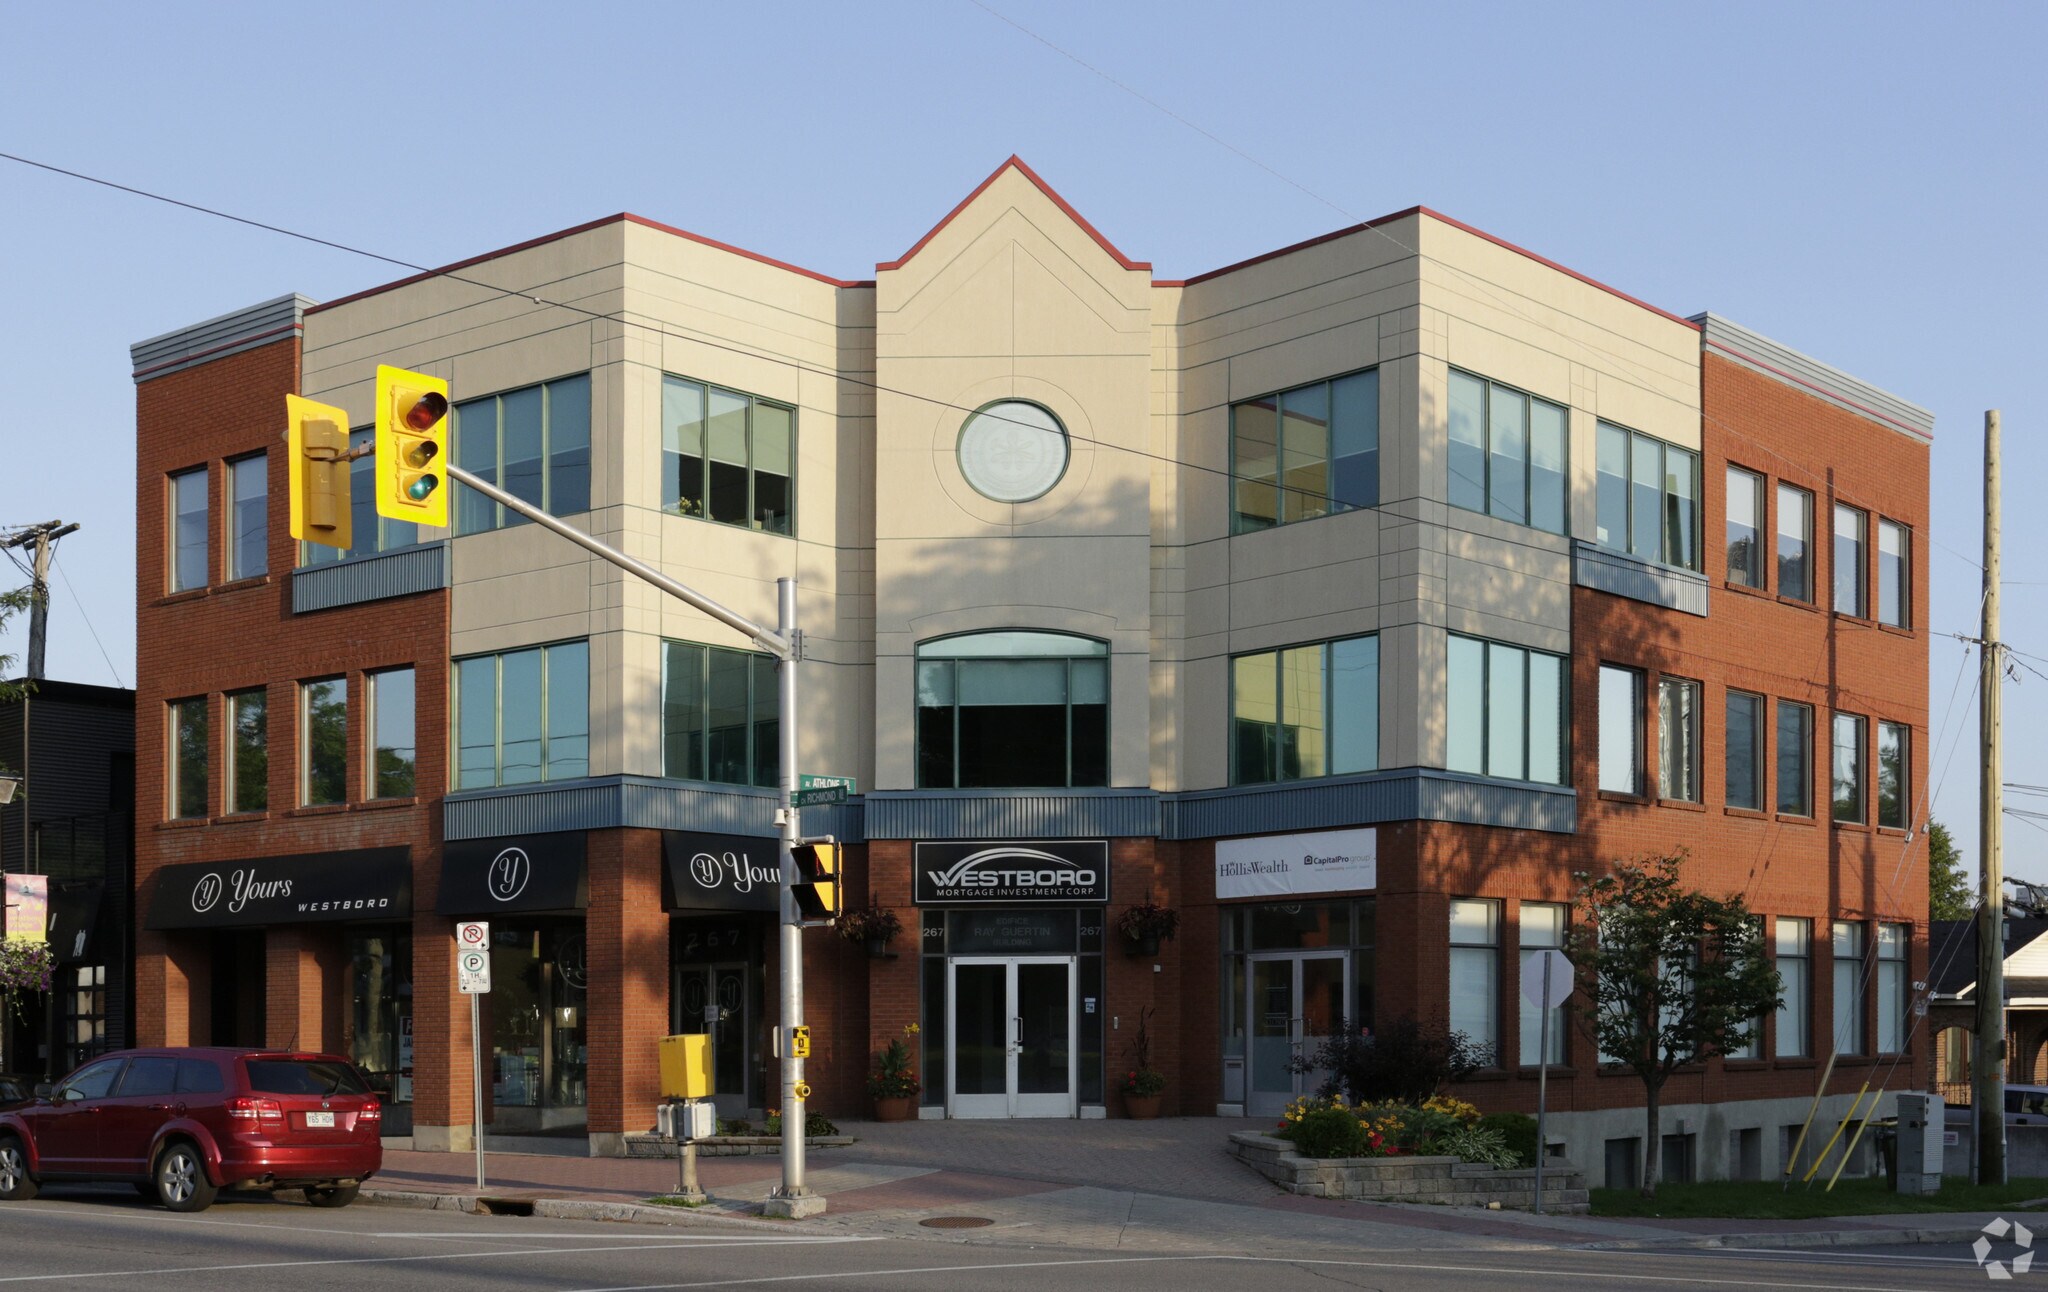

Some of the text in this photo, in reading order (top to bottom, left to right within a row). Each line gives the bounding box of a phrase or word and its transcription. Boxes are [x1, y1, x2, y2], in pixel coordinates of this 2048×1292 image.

[806, 790, 837, 804] RICHMOND
[1313, 855, 1371, 865] CapitalPro group
[228, 868, 293, 913] Yours
[936, 887, 1096, 897] MORTGAGE INVESTMENT CORP.
[298, 898, 388, 912] WESTBORO
[923, 927, 944, 937] 267
[974, 927, 1051, 937] RAY GUERTIN
[1080, 926, 1102, 936] 267
